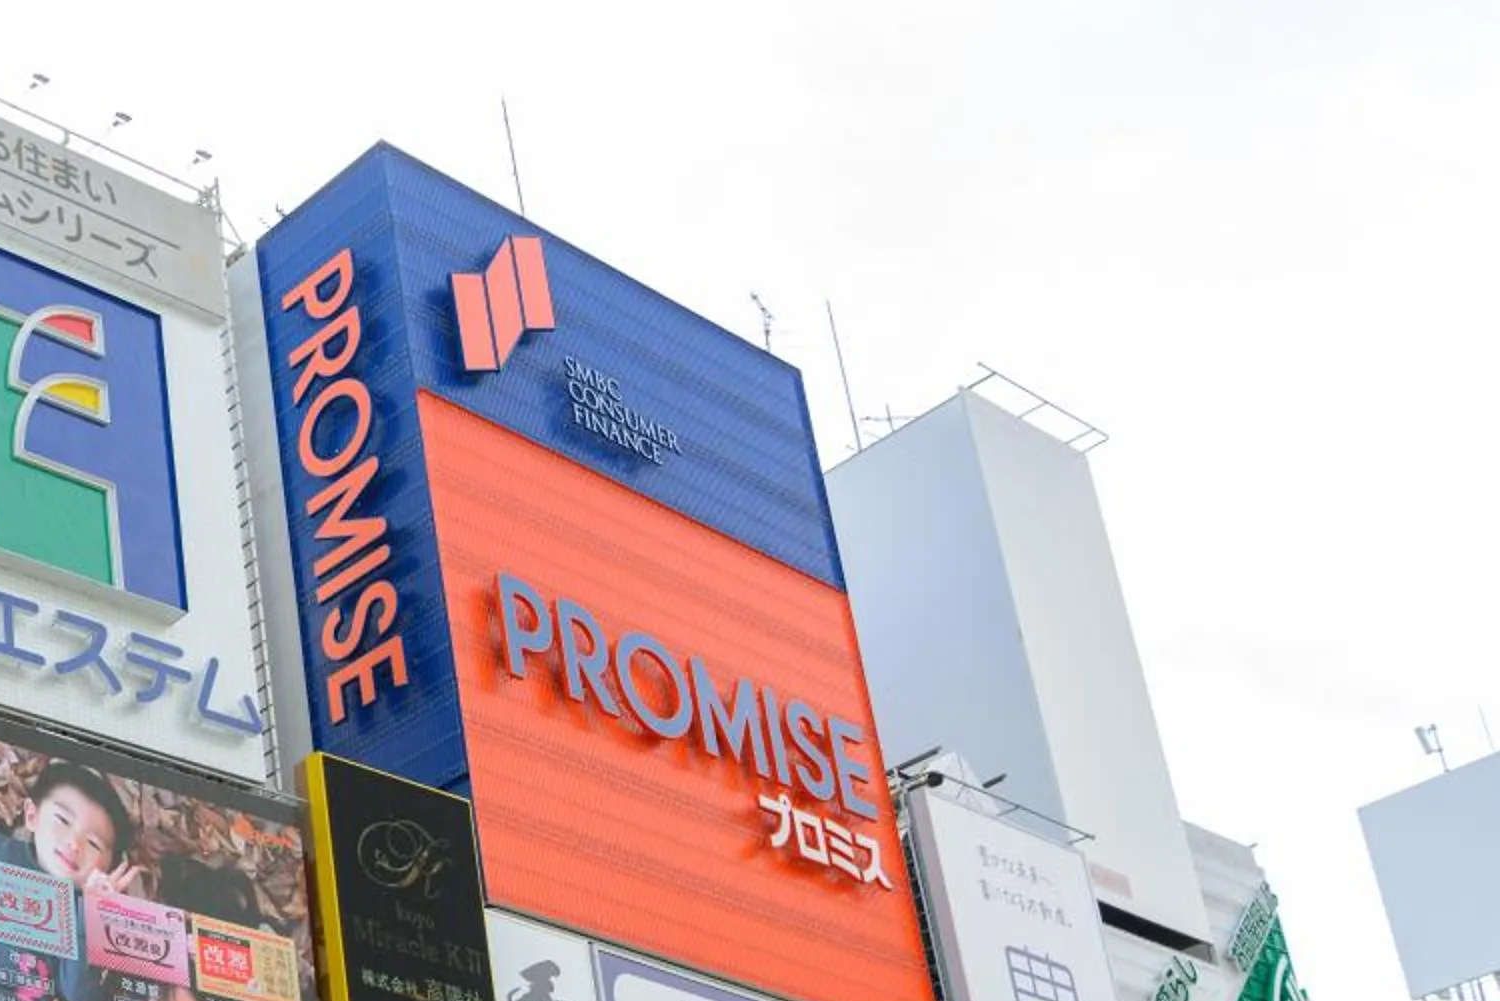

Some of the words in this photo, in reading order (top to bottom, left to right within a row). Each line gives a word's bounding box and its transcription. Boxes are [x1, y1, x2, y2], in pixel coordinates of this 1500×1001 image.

[564, 355, 623, 402] SMBC
[568, 379, 683, 456] CONSUMER
[572, 401, 664, 466] FINANCE
[282, 248, 408, 725] PROMISE
[498, 571, 879, 820] PROMISE
[758, 793, 893, 890] プロミス
